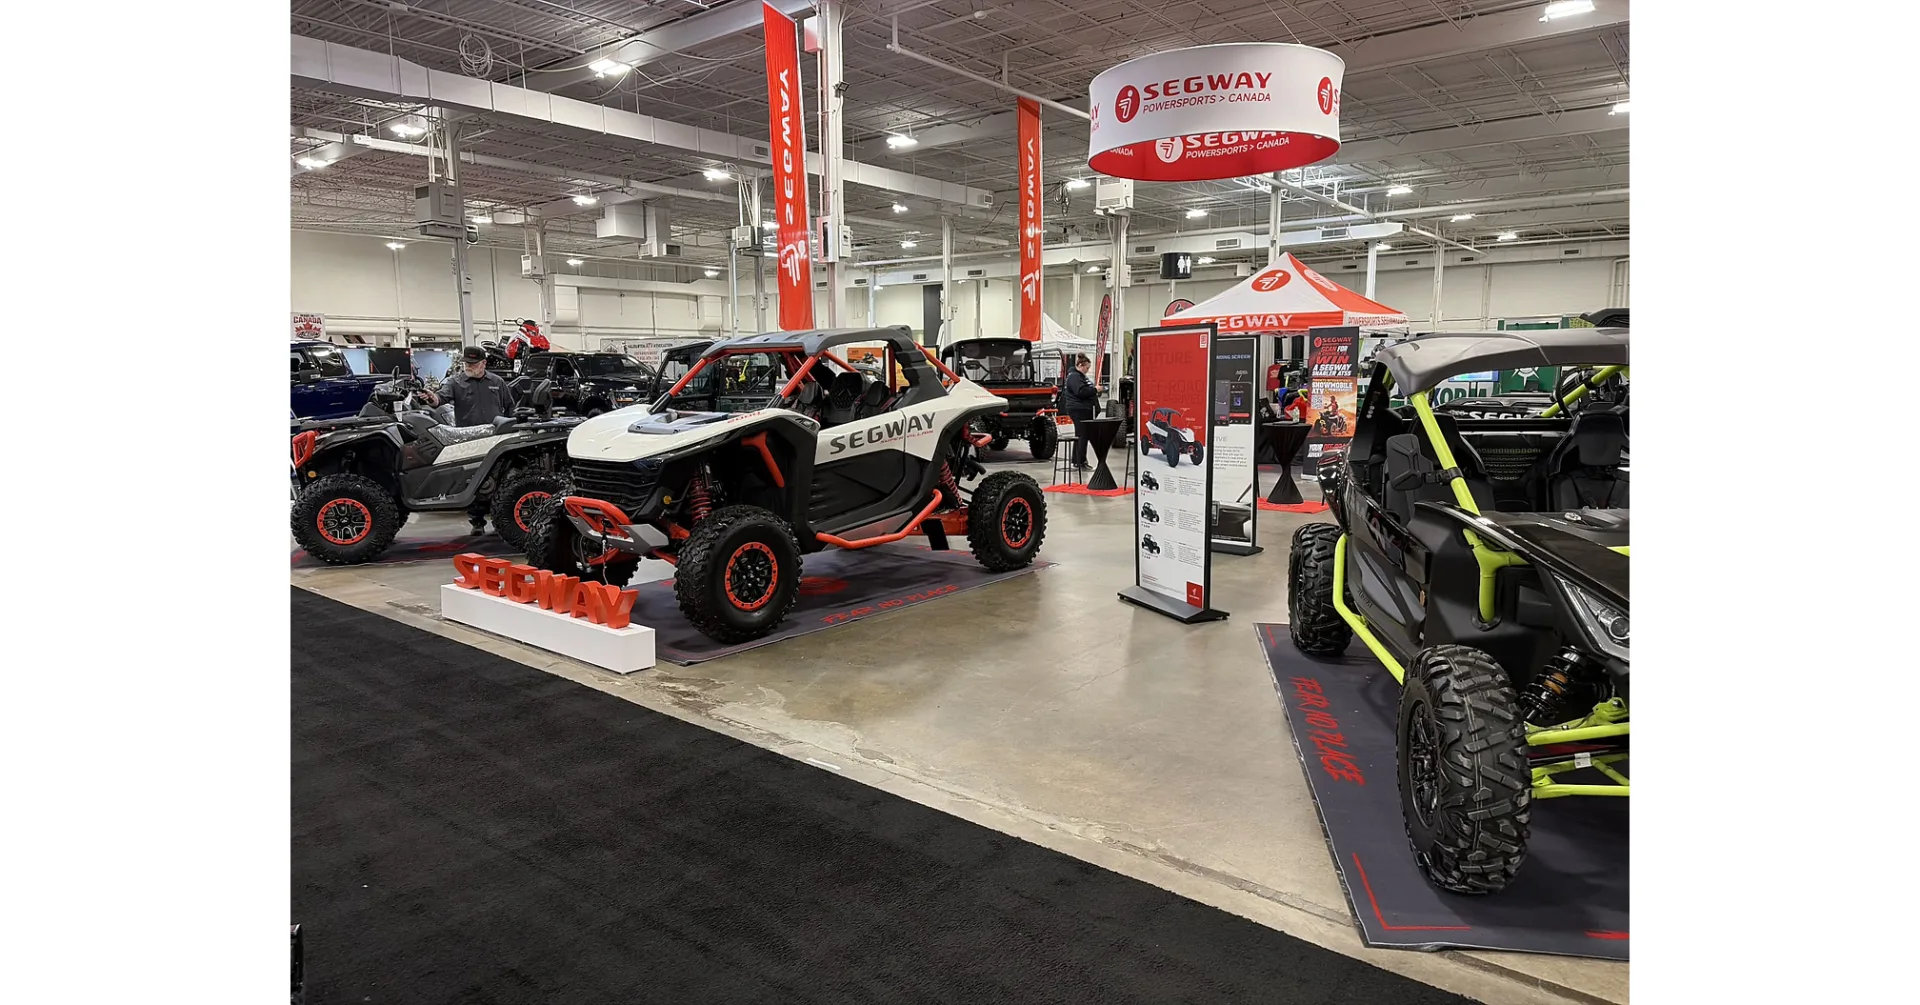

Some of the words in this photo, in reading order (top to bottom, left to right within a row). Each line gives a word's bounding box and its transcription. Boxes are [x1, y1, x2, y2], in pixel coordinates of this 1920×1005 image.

[1143, 72, 1272, 101] SEGWAY
[1142, 95, 1216, 114] POWERSPORTS
[1228, 93, 1271, 103] CANADA
[1185, 144, 1248, 159] POWERSPORTS
[1256, 137, 1290, 150] CANADA
[293, 316, 322, 324] CANADA
[1316, 356, 1349, 364] WIN
[830, 412, 937, 455] SEGWAY
[453, 553, 640, 629] SEGWAY
[1308, 729, 1366, 785] PLACE
